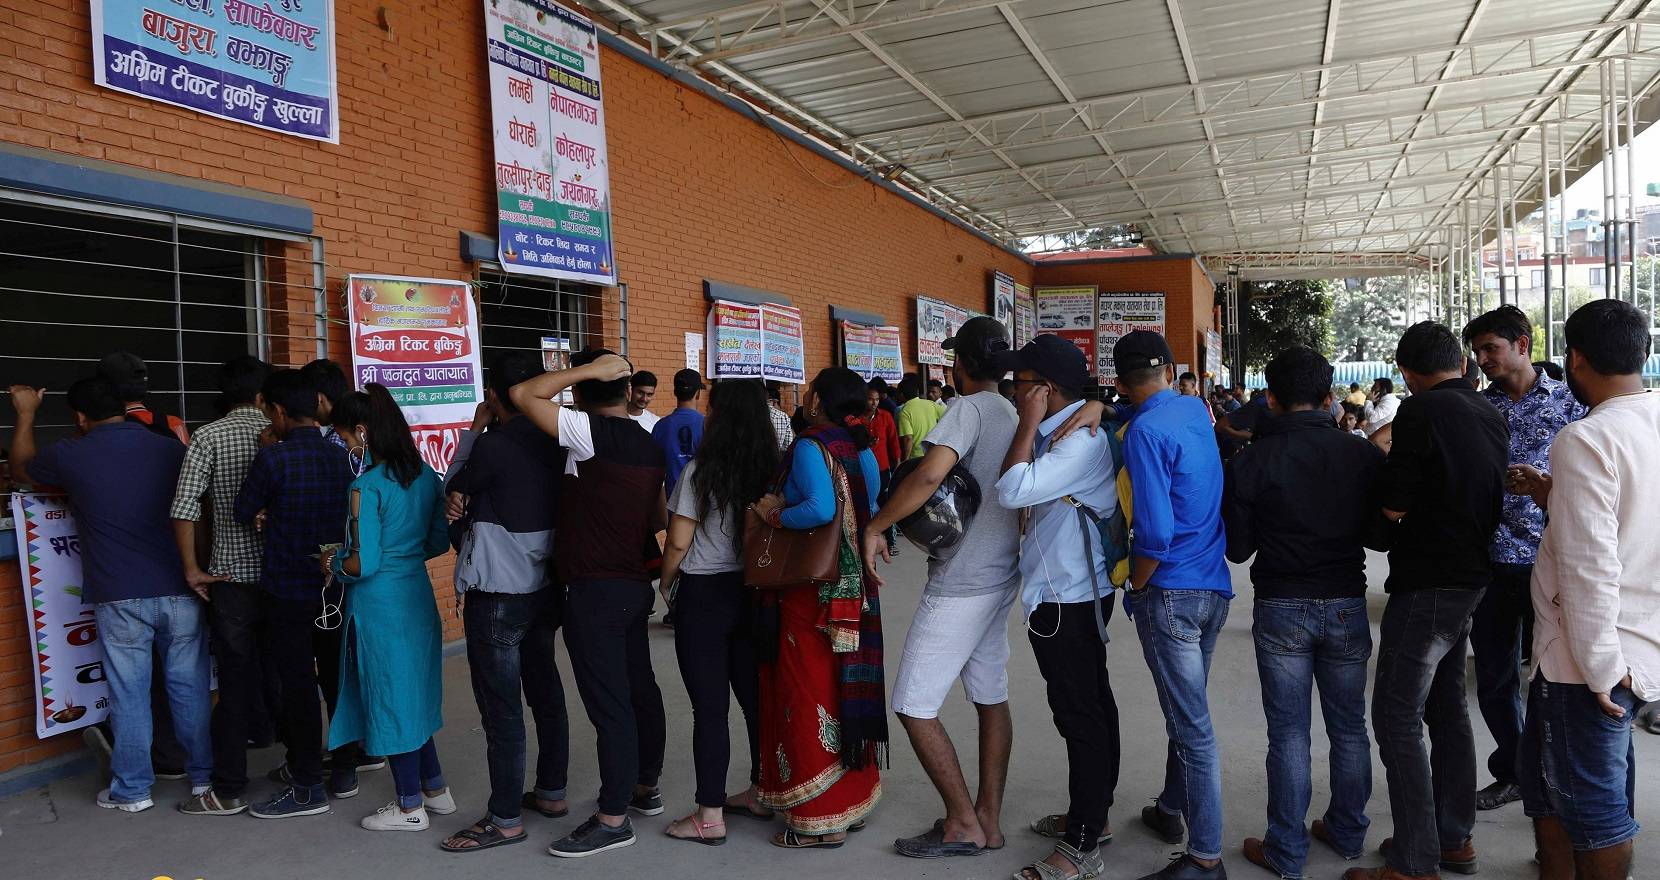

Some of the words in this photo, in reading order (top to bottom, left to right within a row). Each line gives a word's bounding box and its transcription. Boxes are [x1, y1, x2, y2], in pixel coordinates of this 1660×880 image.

[143, 8, 217, 57] बाजुरा,
[223, 0, 319, 50] साफेबगर
[111, 50, 168, 85] अग्रिम
[171, 66, 220, 100] टीकट
[273, 98, 324, 124] खुल्ला
[508, 77, 533, 104] लमही
[509, 116, 536, 148] घोराही
[555, 132, 597, 170] कोहलपुर
[536, 234, 555, 248] टिकट
[364, 335, 395, 354] अग्रिम
[400, 335, 430, 351] टिकट
[361, 366, 379, 383] श्री
[424, 367, 469, 381] यातायात
